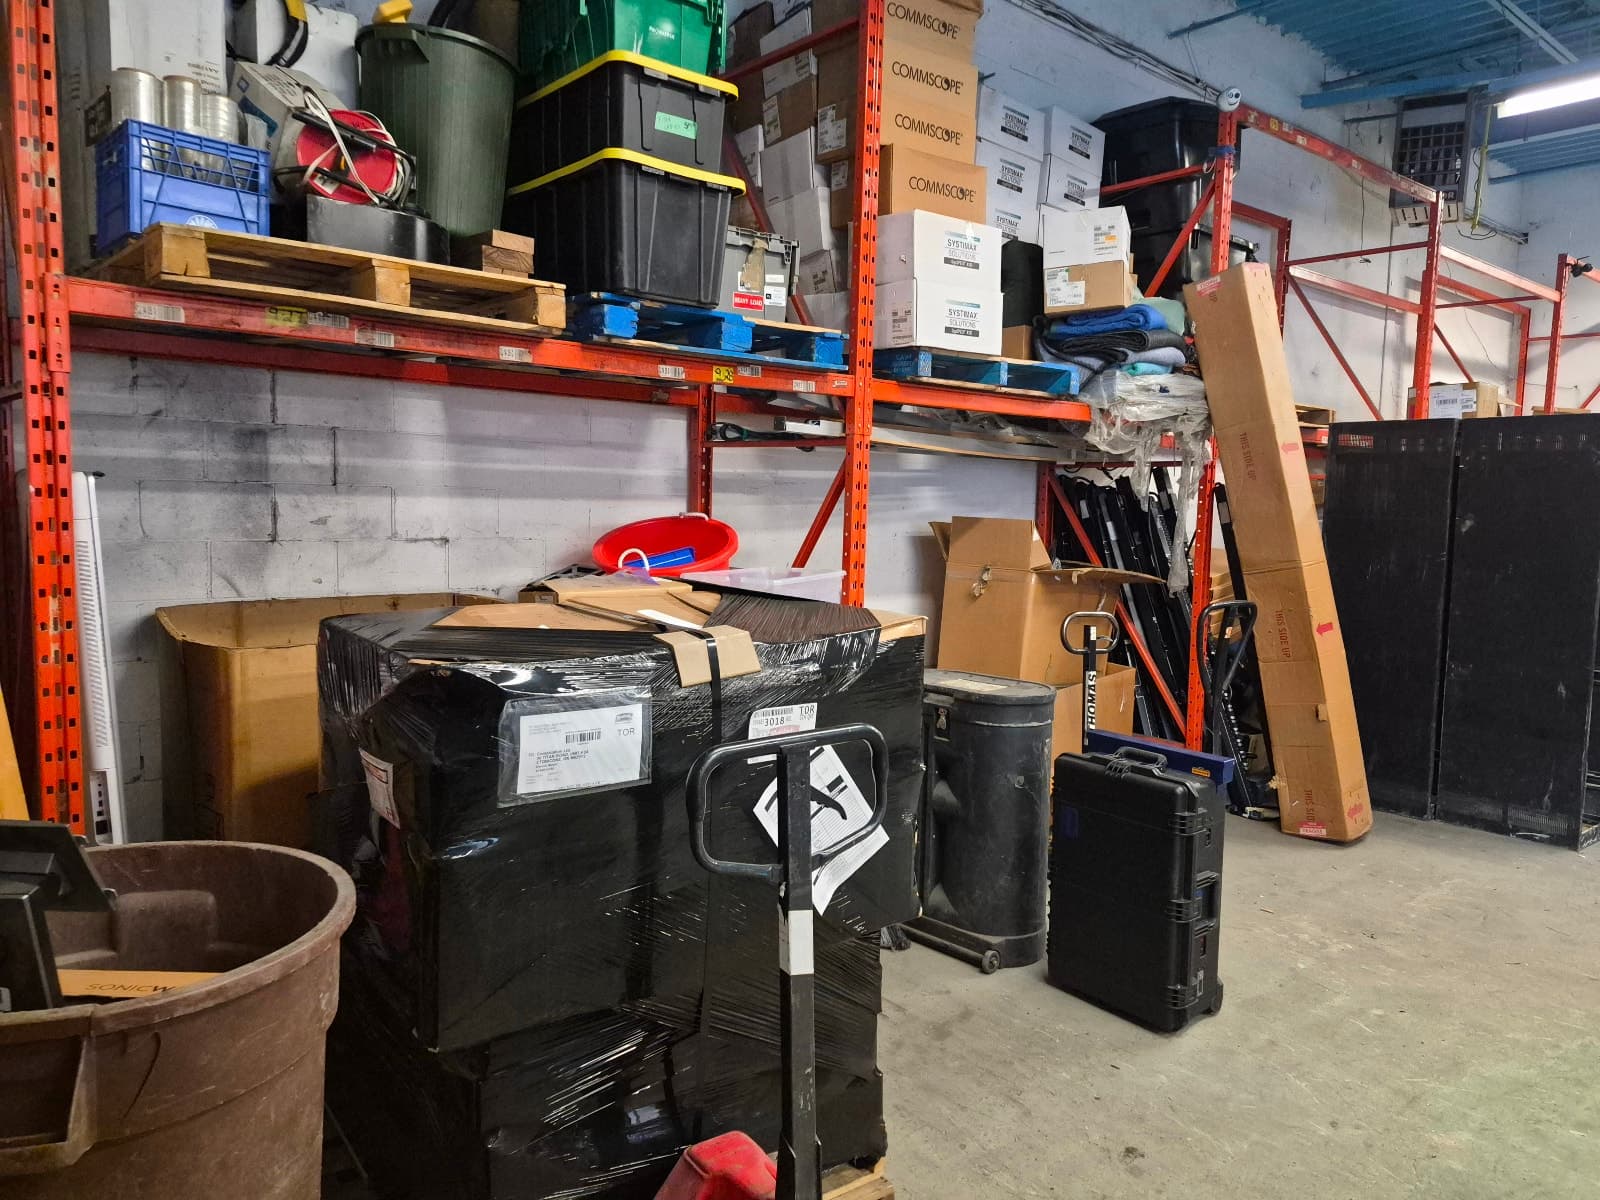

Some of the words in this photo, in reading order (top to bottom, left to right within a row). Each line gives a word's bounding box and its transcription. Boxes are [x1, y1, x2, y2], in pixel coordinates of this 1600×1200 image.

[886, 2, 959, 39] COMMSCOPE
[891, 61, 961, 95] COMMSCOPE
[894, 113, 961, 146] COMMSCOPE
[908, 176, 975, 203] COMMSCOPE
[947, 238, 977, 251] SYSTIMAX
[734, 296, 749, 305] HEAVY
[750, 298, 763, 306] LOAD
[948, 308, 977, 319] SYSTIMAX
[949, 318, 977, 329] SOLUTIONS
[1239, 432, 1251, 450] THIS
[1275, 610, 1286, 626] THIS
[1279, 627, 1289, 646] SIDE
[1281, 647, 1291, 658] UP
[764, 717, 785, 727] 3018
[617, 727, 635, 737] TOR
